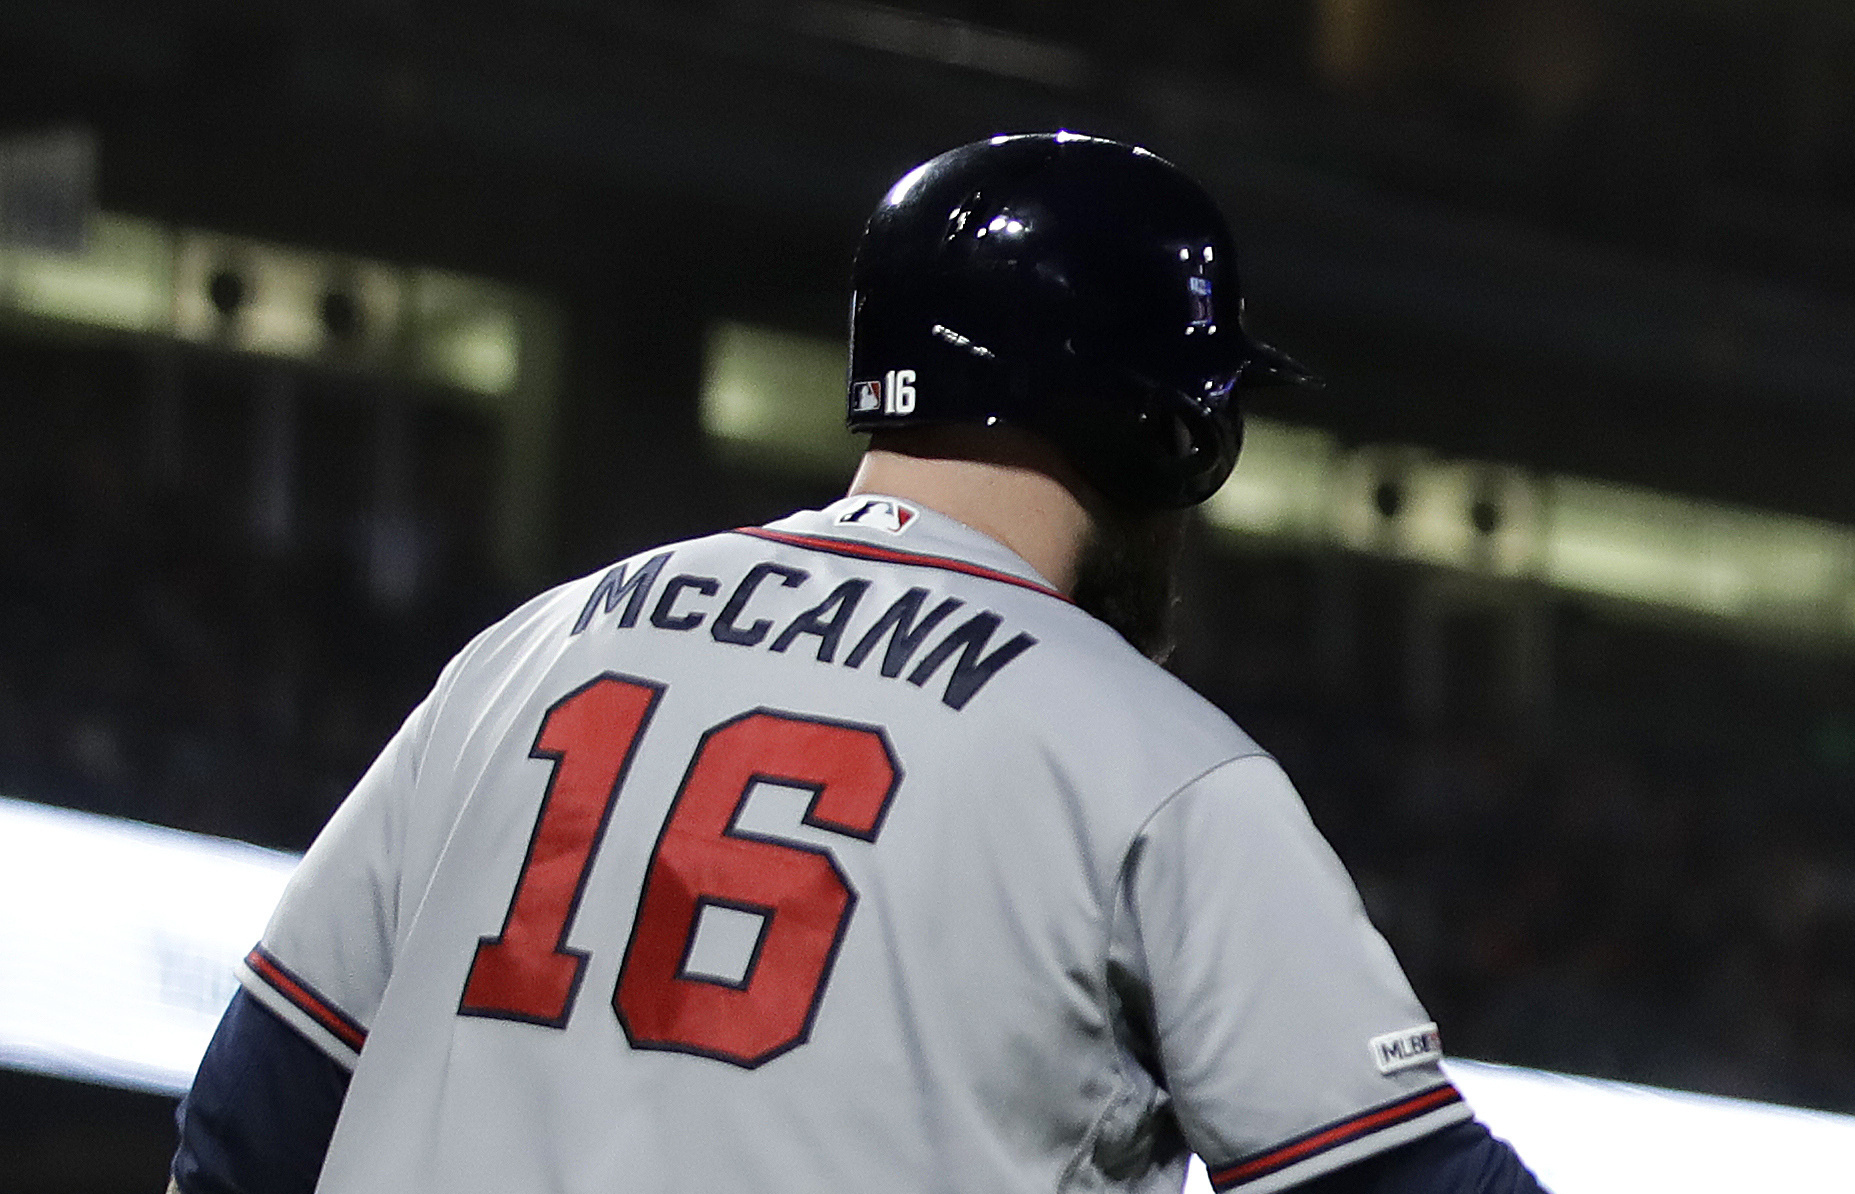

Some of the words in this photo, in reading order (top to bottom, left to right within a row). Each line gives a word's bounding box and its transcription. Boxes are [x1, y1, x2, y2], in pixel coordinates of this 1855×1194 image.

[884, 369, 917, 416] 16
[570, 550, 1039, 712] McCANN
[456, 670, 906, 1070] 16
